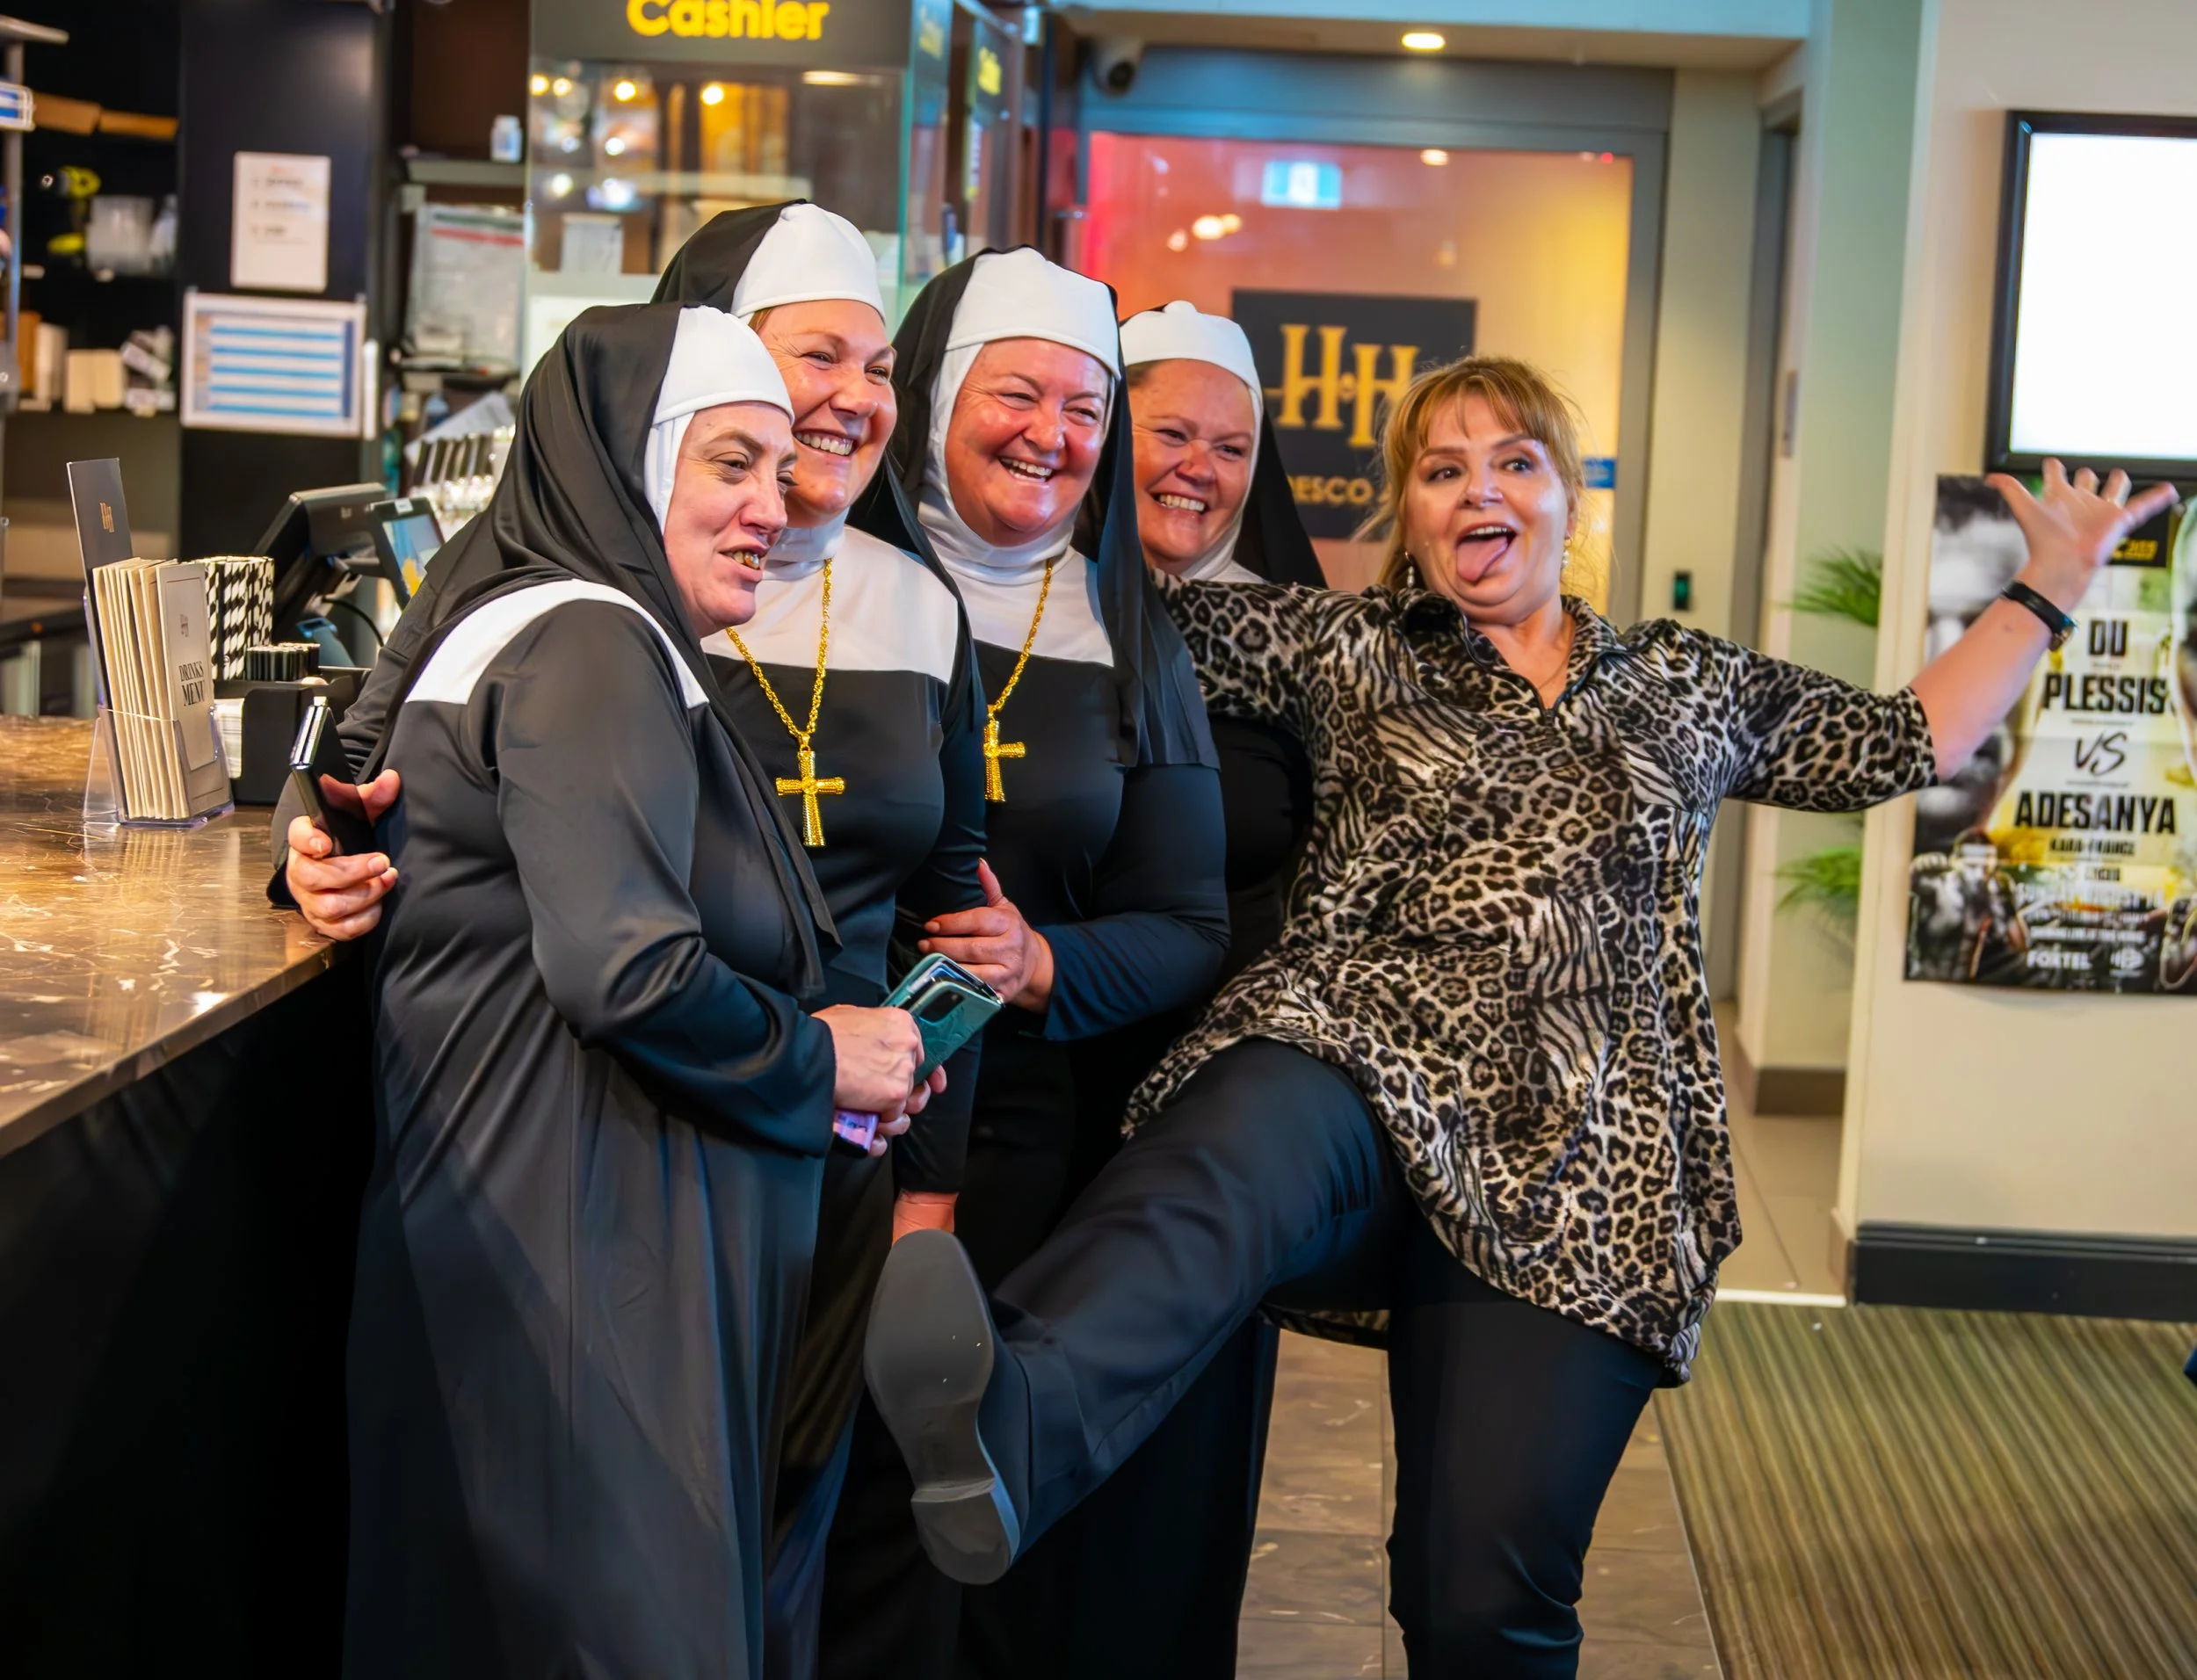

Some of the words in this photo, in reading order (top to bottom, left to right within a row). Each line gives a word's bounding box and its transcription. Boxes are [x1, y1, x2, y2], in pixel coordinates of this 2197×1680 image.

[626, 0, 830, 40] Cashier
[2089, 619, 2128, 657] DU
[178, 661, 205, 682] DRINKS
[2041, 672, 2167, 714] PLESSIS
[2014, 791, 2176, 834] ADESANYA
